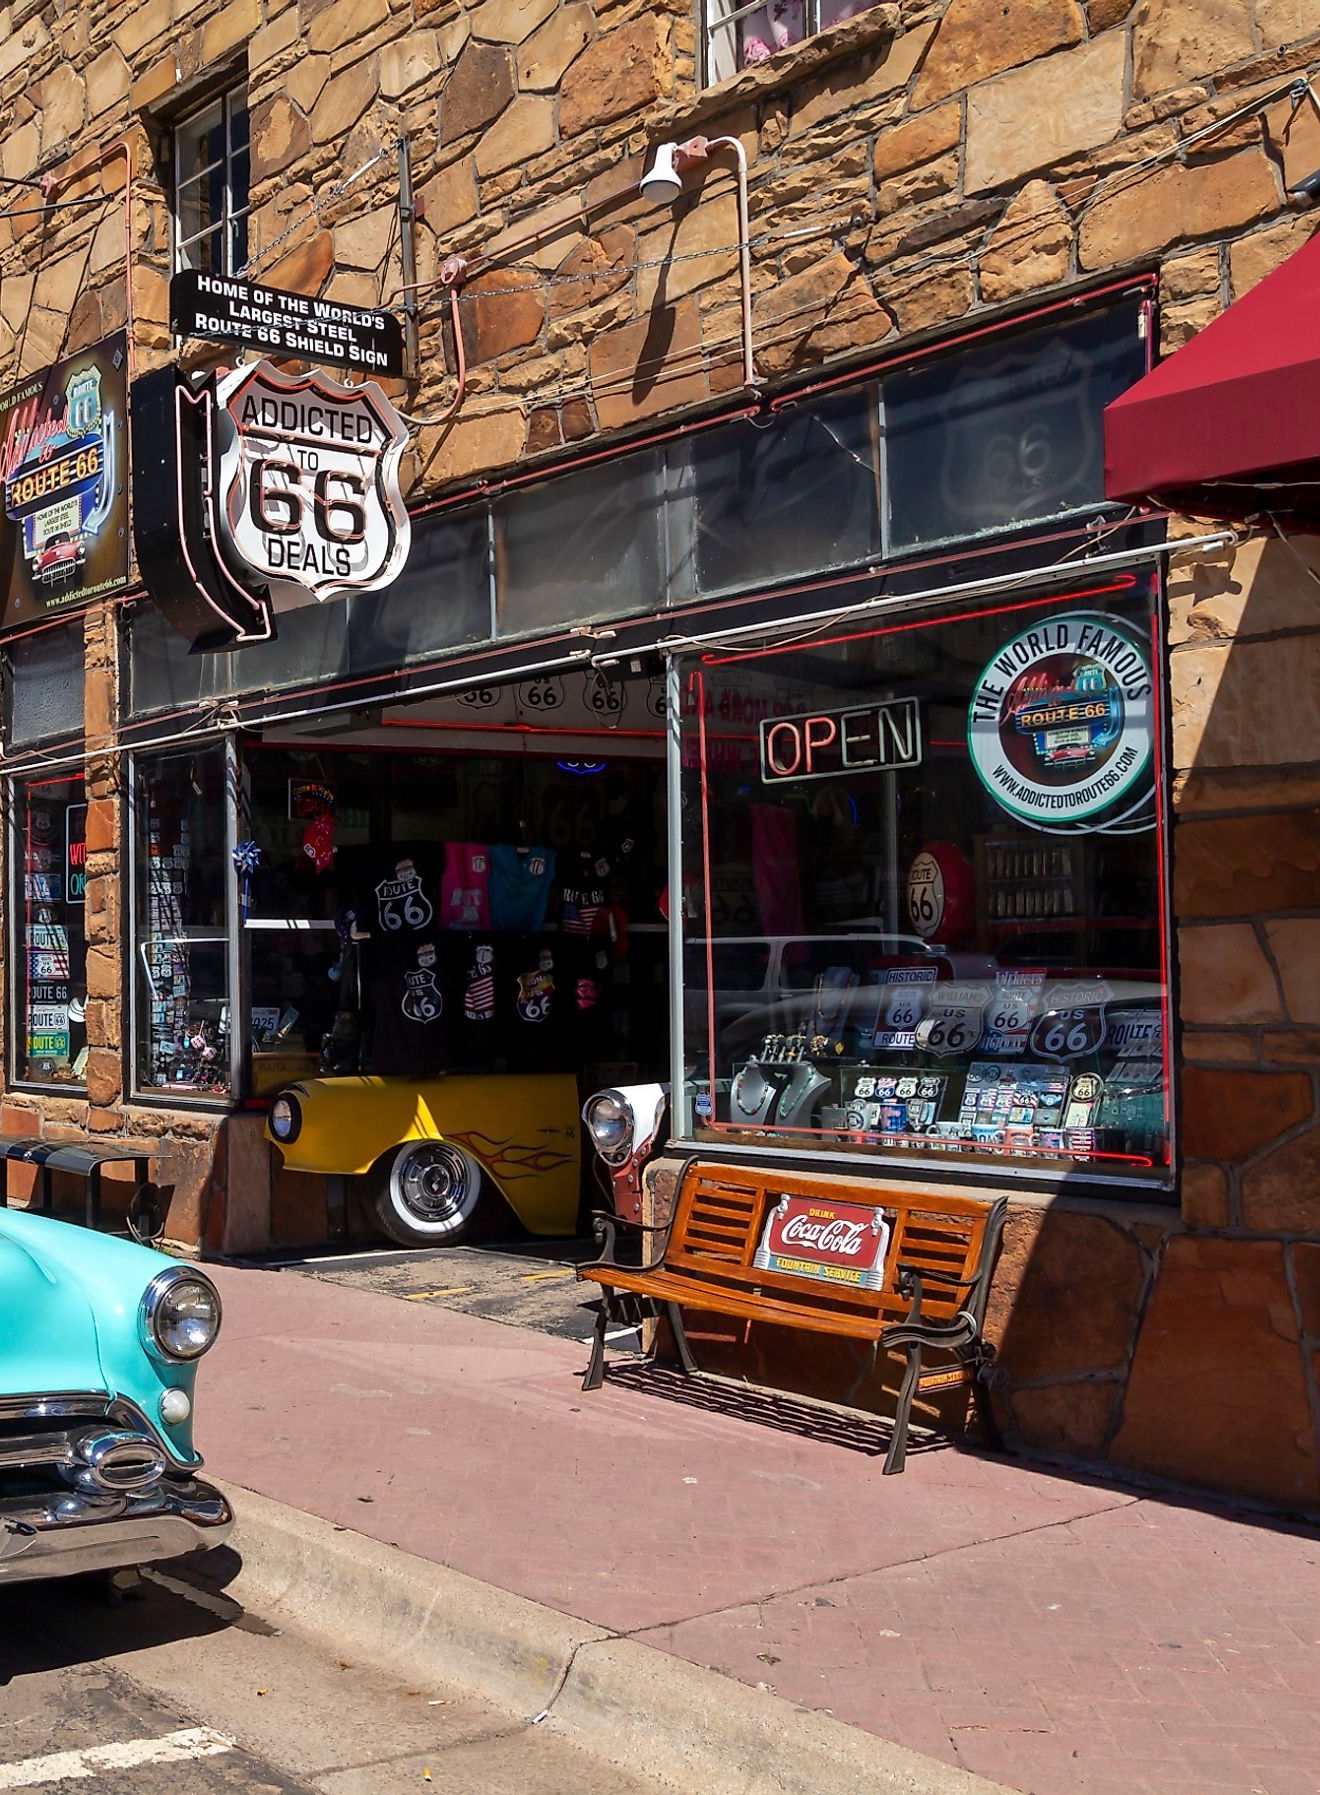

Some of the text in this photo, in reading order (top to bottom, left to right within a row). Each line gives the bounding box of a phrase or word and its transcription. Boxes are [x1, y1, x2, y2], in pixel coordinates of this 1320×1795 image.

[197, 276, 386, 330] HOME OF THE WORLD'S
[229, 301, 357, 342] LARGEST STEEL
[195, 312, 388, 367] ROUTE 66 SHIELD SIGN
[16, 382, 43, 406] FAMOUS
[76, 403, 92, 428] 66
[242, 395, 373, 443] ADDICTED
[297, 450, 319, 470] TO
[11, 448, 99, 514] ROUTE 66
[250, 458, 366, 545] 66
[267, 538, 351, 577] DEALS
[45, 575, 127, 608] www.addictedtoroute66.com
[973, 624, 1152, 723] THE WORLD FAMOUS
[528, 686, 557, 706] 66
[593, 691, 620, 710] 66
[1020, 703, 1106, 728] ROUTE 66
[767, 704, 912, 776] OPEN
[992, 746, 1139, 809] WWW.ADDICTEDTOROUTE66.COM
[911, 868, 932, 881] ROUTE
[384, 896, 424, 930] 66
[910, 886, 934, 922] 66
[41, 966, 53, 974] 66
[888, 971, 933, 983] HISTORIC
[56, 986, 67, 999] 66
[1050, 991, 1102, 1005] HISTORIC
[893, 1008, 913, 1023] 66
[943, 1009, 966, 1018] US
[995, 1011, 1019, 1028] 66
[1060, 1009, 1084, 1020] US
[882, 1033, 915, 1044] ROUTE
[928, 1020, 966, 1047] 66
[1045, 1023, 1087, 1052] 66
[1108, 1024, 1153, 1046] ROUTE
[879, 1088, 891, 1096] 66
[921, 1088, 934, 1096] 66
[1078, 1088, 1091, 1097] 66
[808, 1208, 836, 1220] DRINK
[781, 1214, 869, 1256] Coca-Cola
[776, 1257, 861, 1283] FOUNTAIN SERVICE
